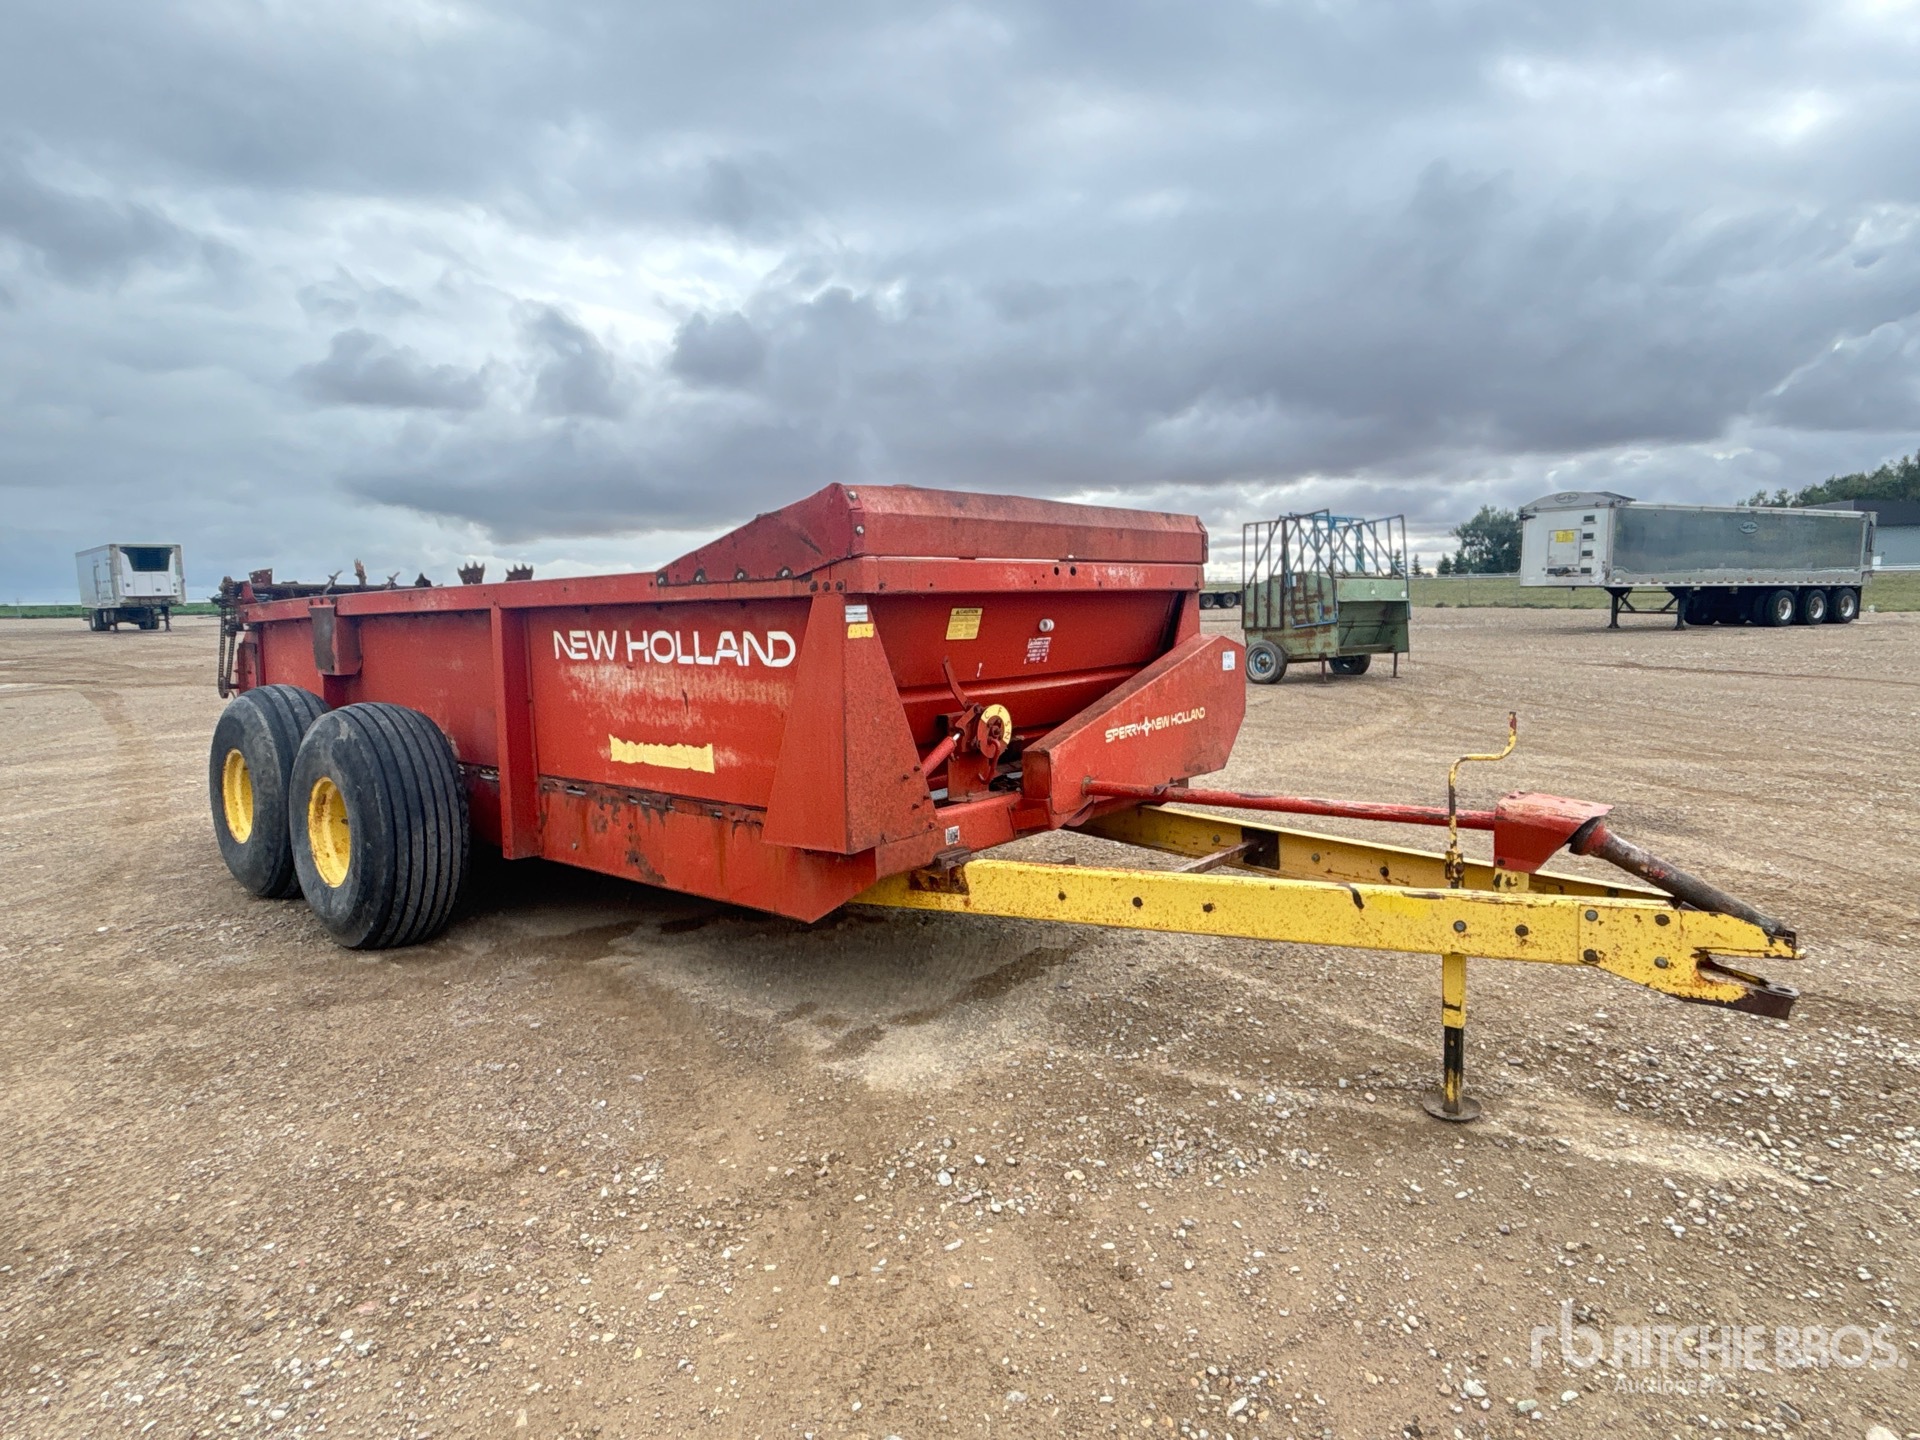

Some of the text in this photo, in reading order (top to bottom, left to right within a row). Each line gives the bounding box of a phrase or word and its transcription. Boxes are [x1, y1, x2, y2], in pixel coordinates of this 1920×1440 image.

[553, 630, 796, 667] NEW HOLLAND
[1105, 707, 1206, 743] SPERRY NEW HOLLAND
